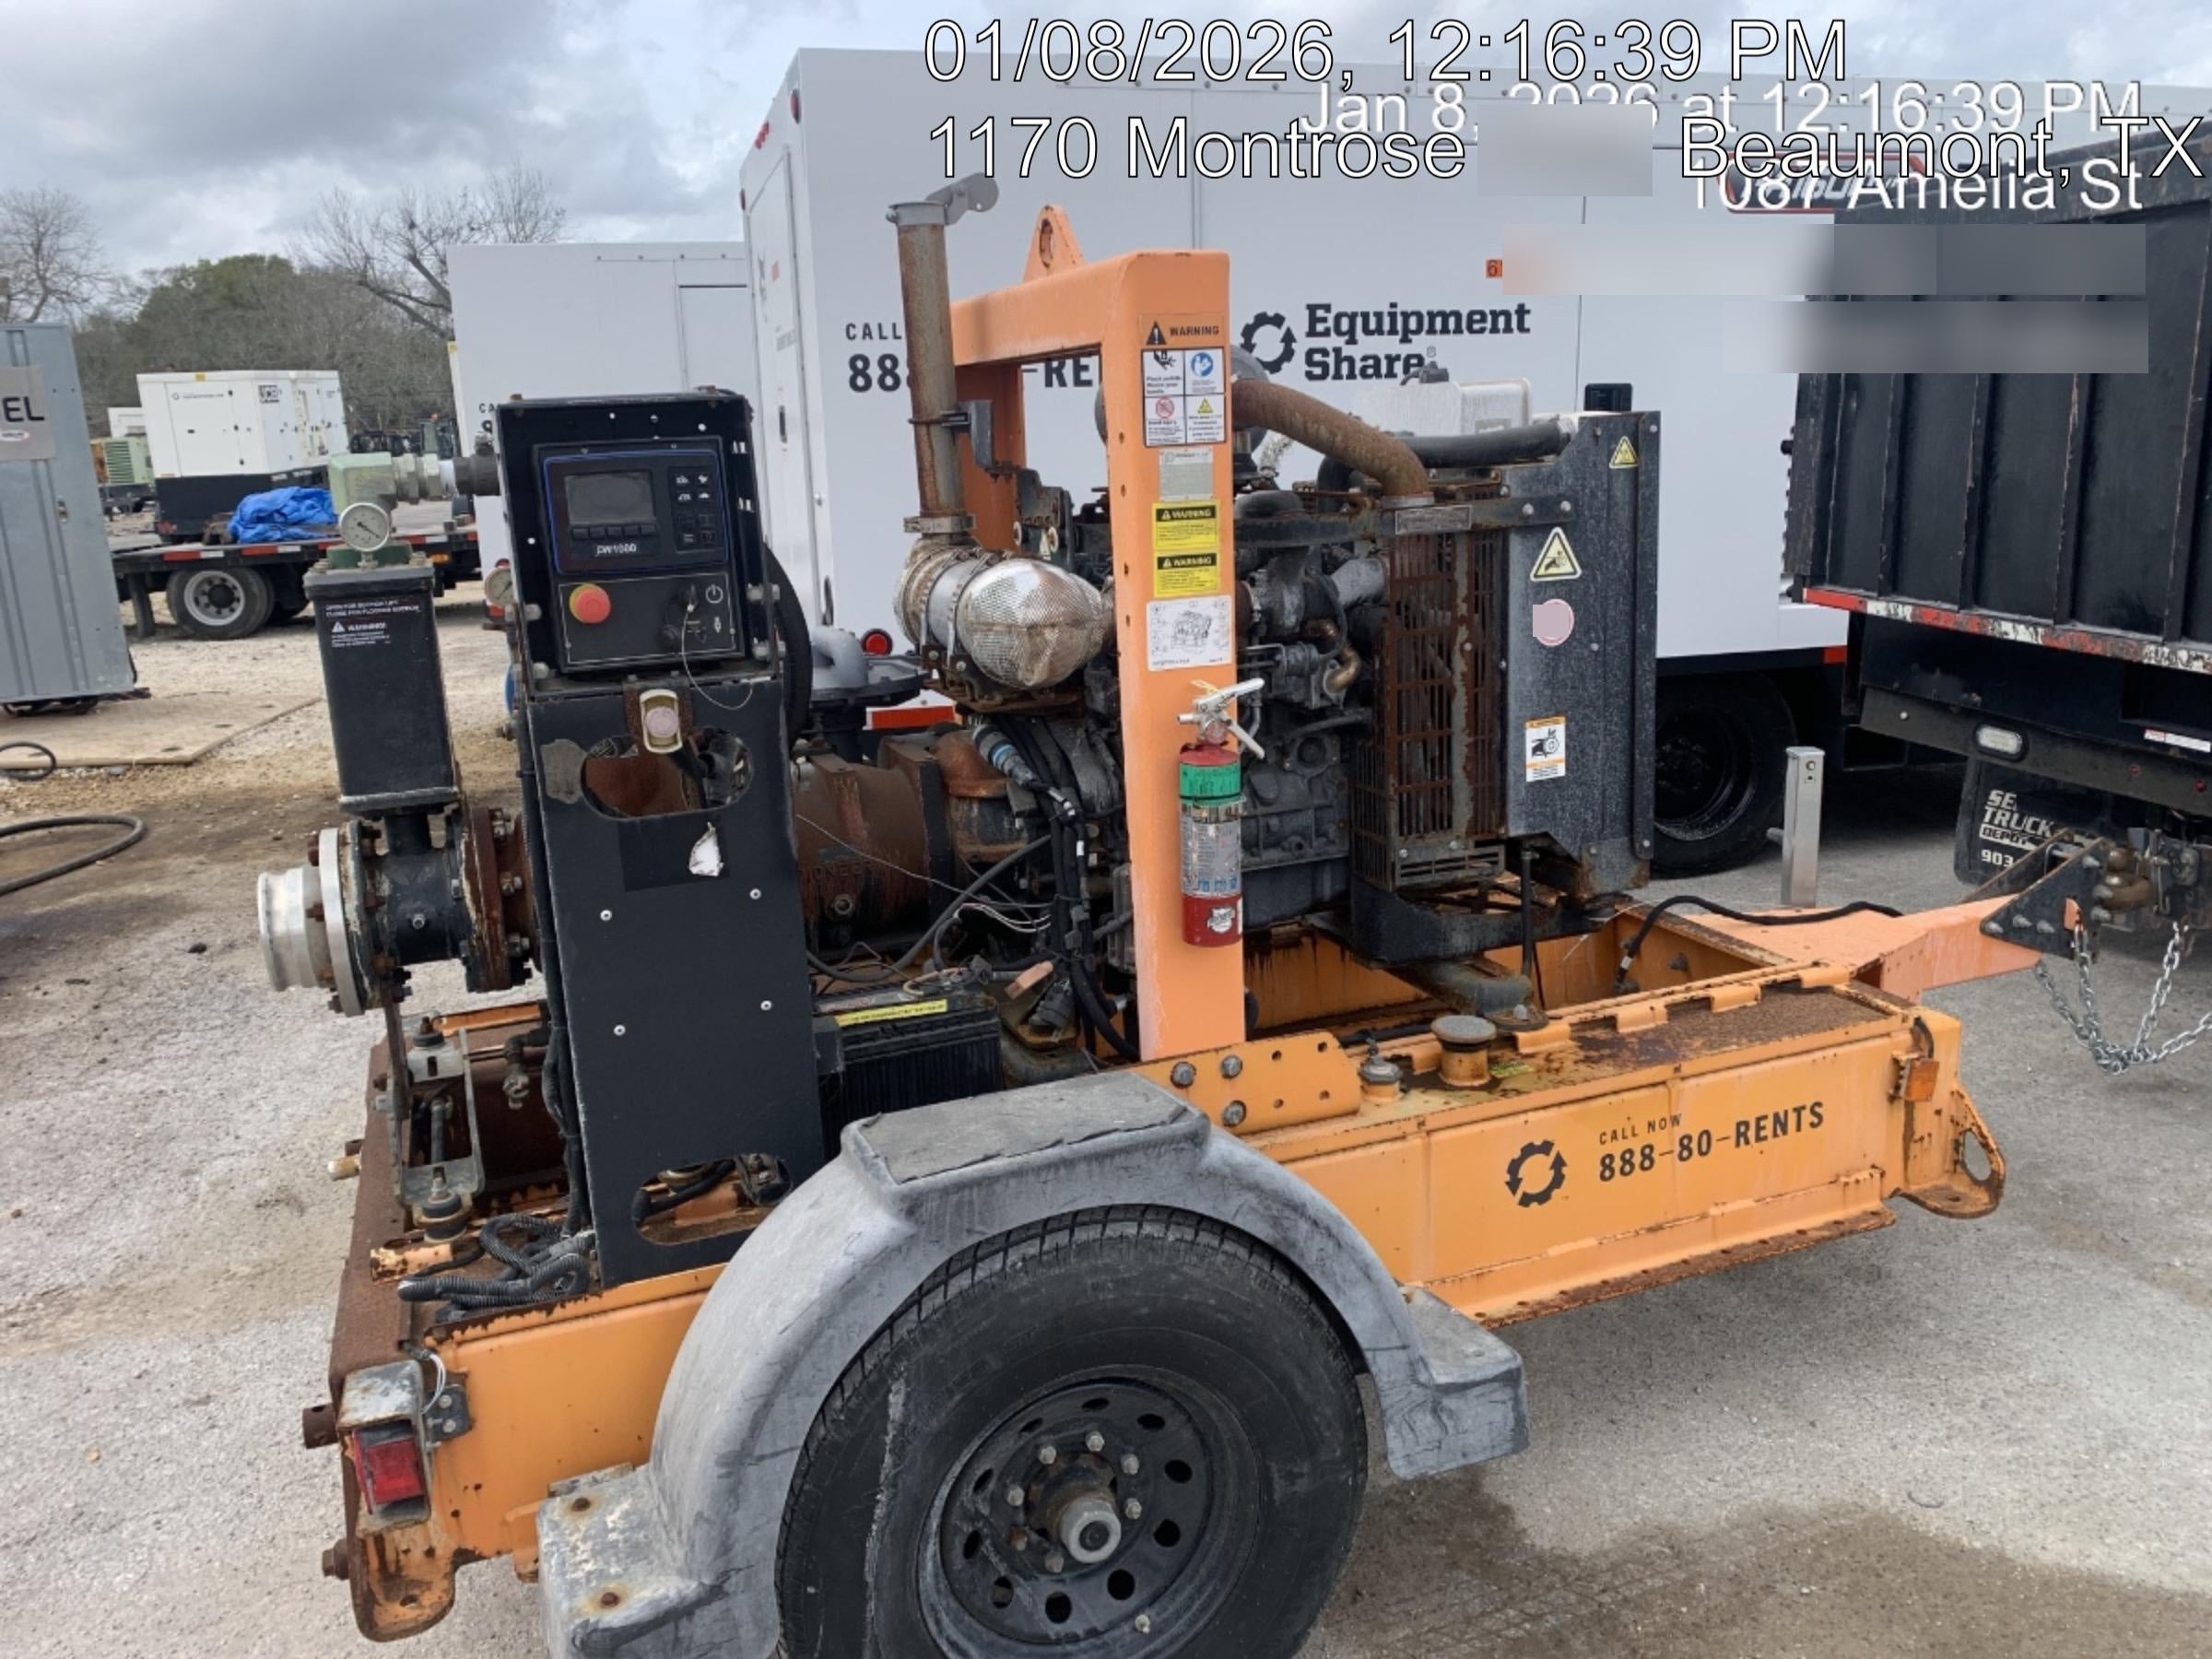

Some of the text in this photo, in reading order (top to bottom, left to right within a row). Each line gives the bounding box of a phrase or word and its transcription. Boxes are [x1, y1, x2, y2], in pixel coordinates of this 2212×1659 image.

[845, 323, 902, 340] CALL
[1170, 325, 1219, 336] WARNING
[1305, 302, 1531, 346] Equipment
[1304, 347, 1427, 382] Share
[1983, 805, 2054, 838] TRUCK
[1599, 1112, 1682, 1147] CALL NOW
[1599, 1100, 1824, 1182] 888-80-RENTS
